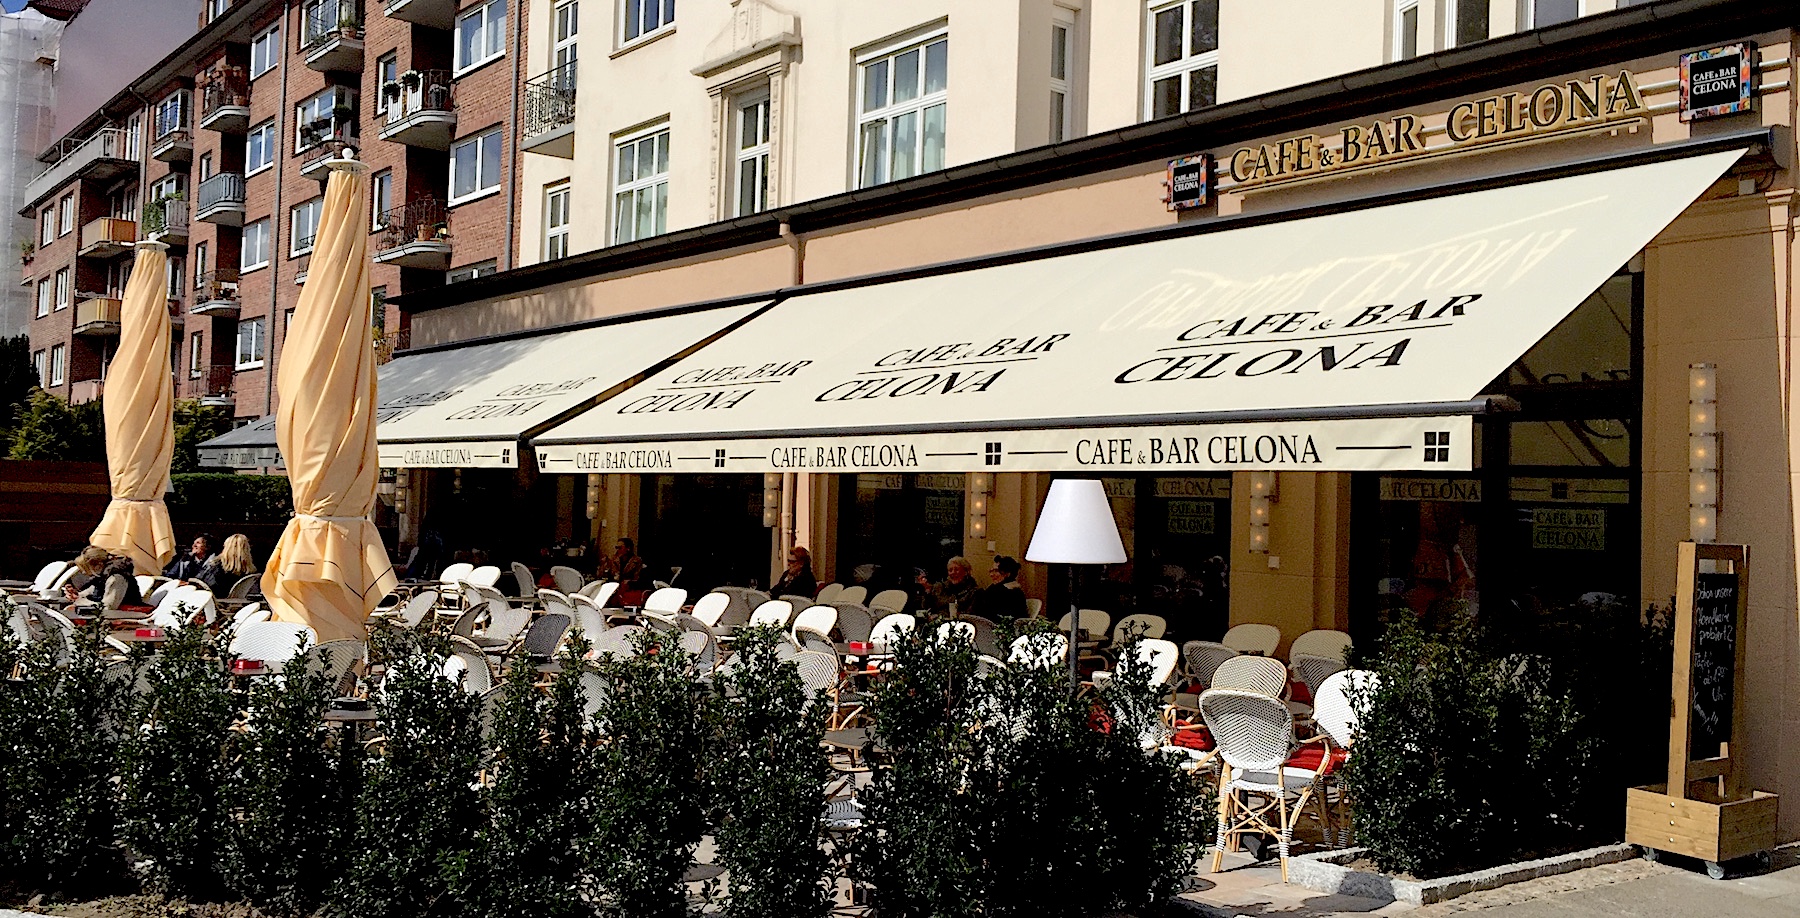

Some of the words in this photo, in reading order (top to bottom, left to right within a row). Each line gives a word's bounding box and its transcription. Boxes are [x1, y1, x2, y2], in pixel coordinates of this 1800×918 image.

[1692, 70, 1714, 82] CAFE
[1718, 67, 1737, 77] BAR
[1692, 79, 1737, 95] CELONA
[1229, 135, 1315, 183] CAFE
[1320, 149, 1335, 167] &
[1341, 114, 1421, 164] BAR
[1446, 69, 1642, 142] CELONA
[1174, 181, 1199, 192] CELONA
[1176, 310, 1320, 341] CAFE
[1309, 318, 1335, 331] &
[1343, 293, 1483, 328] BAR
[874, 342, 973, 367] CAFE
[977, 333, 1071, 357] BAR
[1114, 338, 1412, 384] CELONA
[672, 365, 747, 384] CAFE
[745, 360, 813, 379] BAR
[814, 368, 1007, 402] CELONA
[617, 389, 756, 414] CELONA
[404, 450, 421, 464] CAFE
[425, 449, 440, 464] BAR
[440, 449, 472, 464] CELONA
[576, 451, 600, 469] CAFE
[606, 451, 626, 469] BAR
[628, 449, 673, 469] CELONA
[771, 446, 807, 469] CAFE
[816, 446, 848, 468] BAR
[850, 444, 919, 468] CELONA
[1076, 438, 1133, 465] CAFE
[1137, 450, 1147, 464] &
[1150, 437, 1200, 464] BAR
[1207, 435, 1322, 464] CELONA
[1407, 482, 1480, 500] CELONA
[1536, 512, 1567, 525] CAFE
[1575, 512, 1600, 525] BAR
[1535, 530, 1600, 547] CELONA
